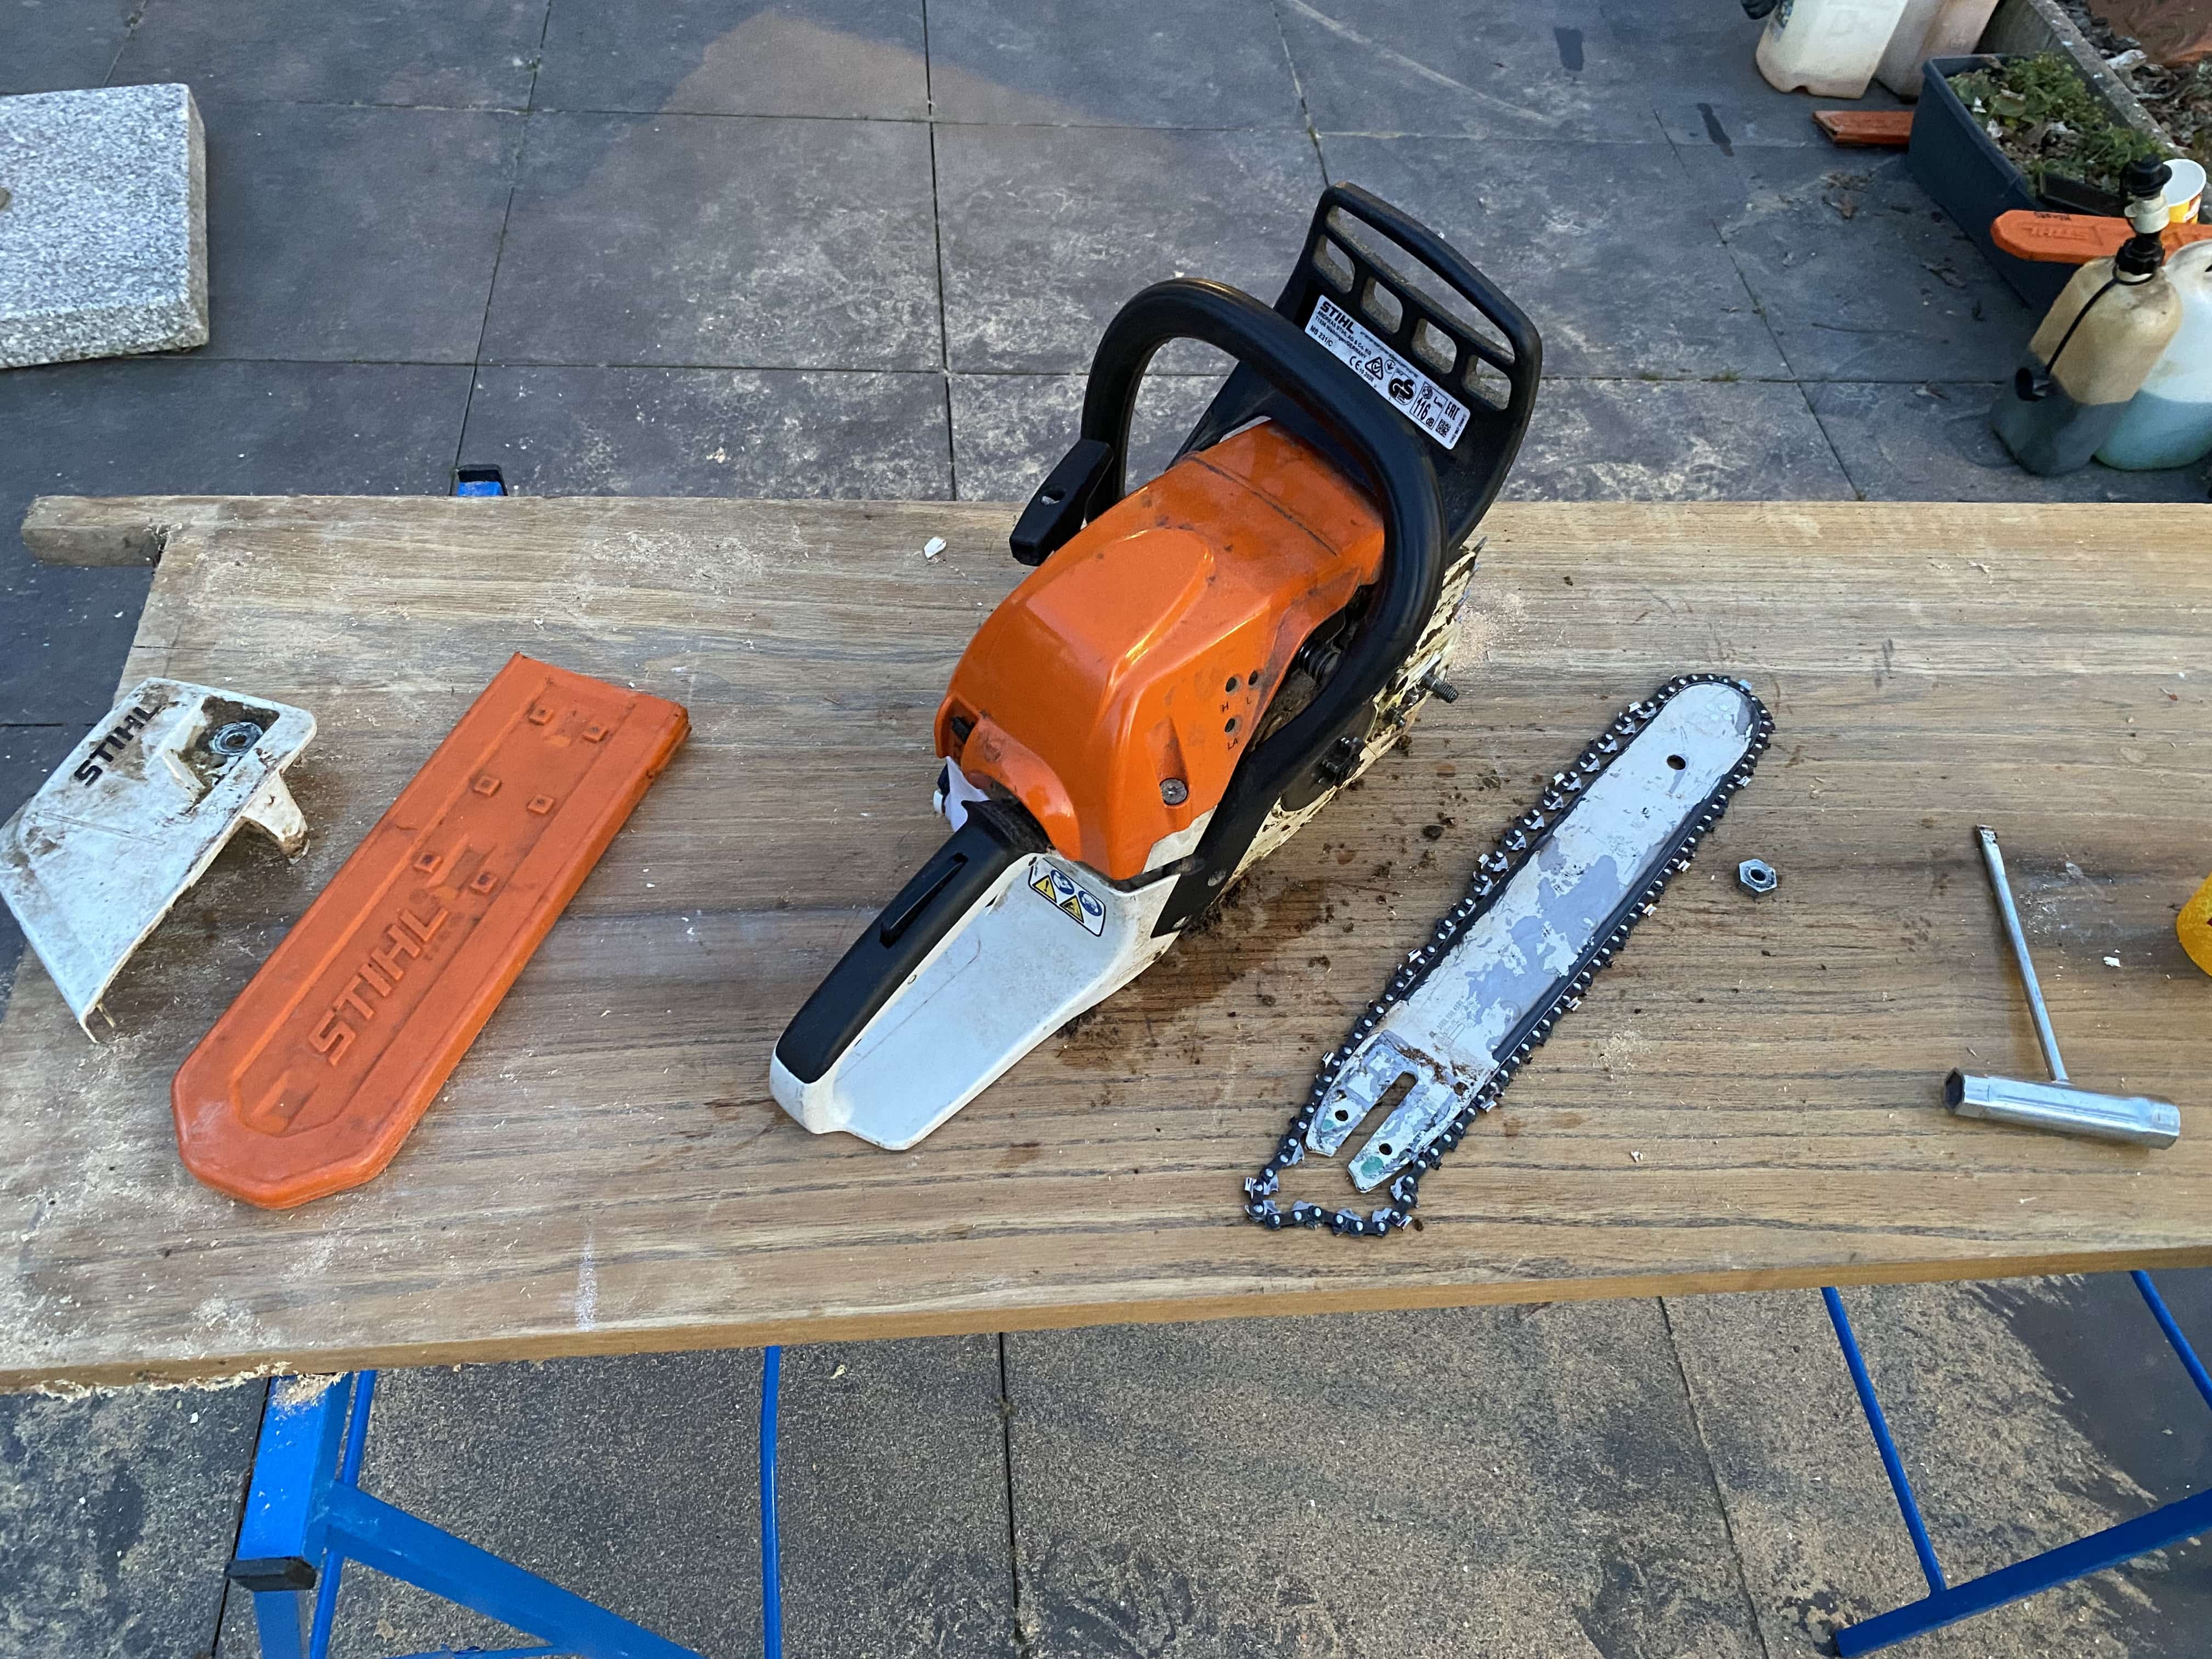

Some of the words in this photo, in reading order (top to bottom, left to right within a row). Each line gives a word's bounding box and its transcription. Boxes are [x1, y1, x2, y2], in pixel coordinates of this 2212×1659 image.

[1320, 301, 1354, 334] STIHL
[1310, 325, 1319, 335] MS
[1318, 332, 1333, 347] 231/C
[1413, 397, 1431, 420] 116
[1426, 417, 1435, 427] dB
[1221, 702, 1229, 713] H
[74, 705, 161, 786] STIHL
[1227, 737, 1238, 751] LA
[308, 908, 449, 1066] STIHL
